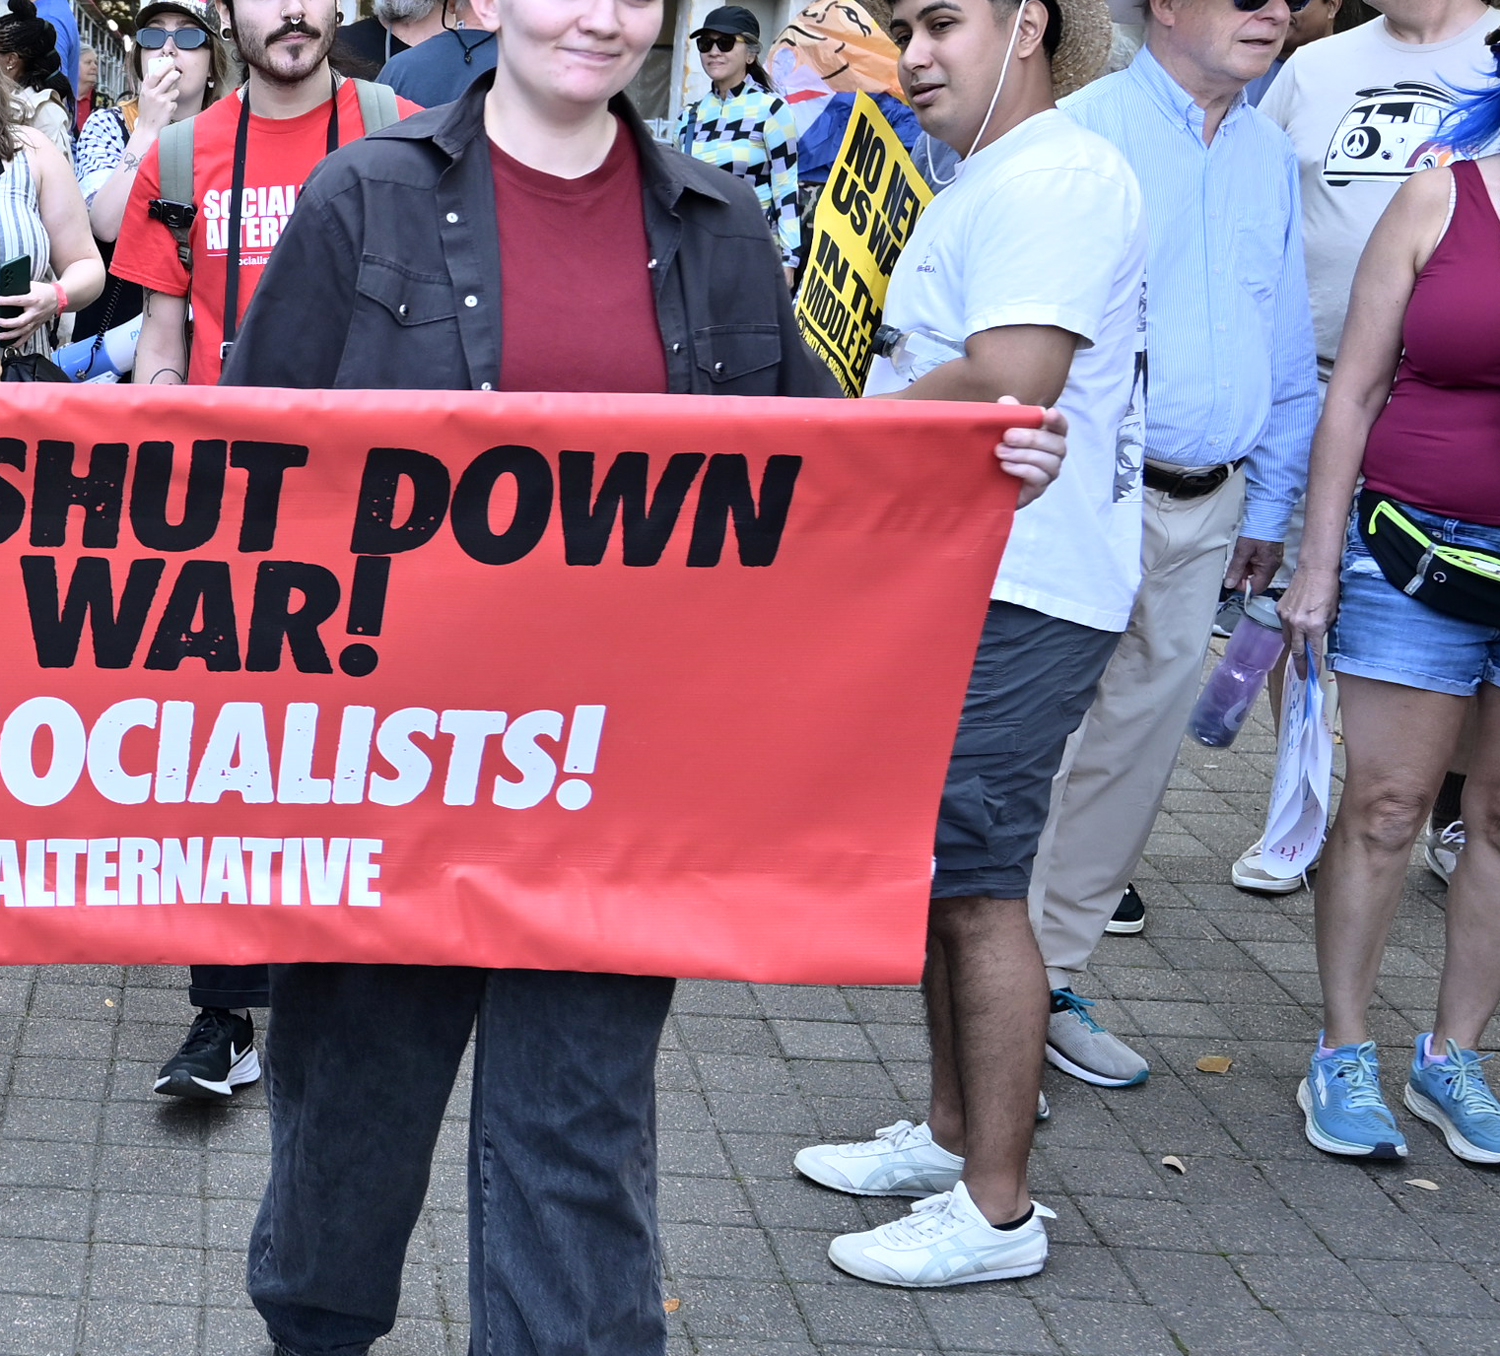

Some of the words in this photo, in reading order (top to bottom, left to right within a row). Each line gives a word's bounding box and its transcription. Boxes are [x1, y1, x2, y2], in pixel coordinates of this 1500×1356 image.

[831, 166, 871, 236] US
[844, 112, 886, 194] NO
[803, 266, 859, 364] MIDDLE
[815, 230, 849, 294] IN
[850, 270, 883, 335] TH
[350, 444, 803, 567] DOWN
[20, 554, 391, 677] WAR!
